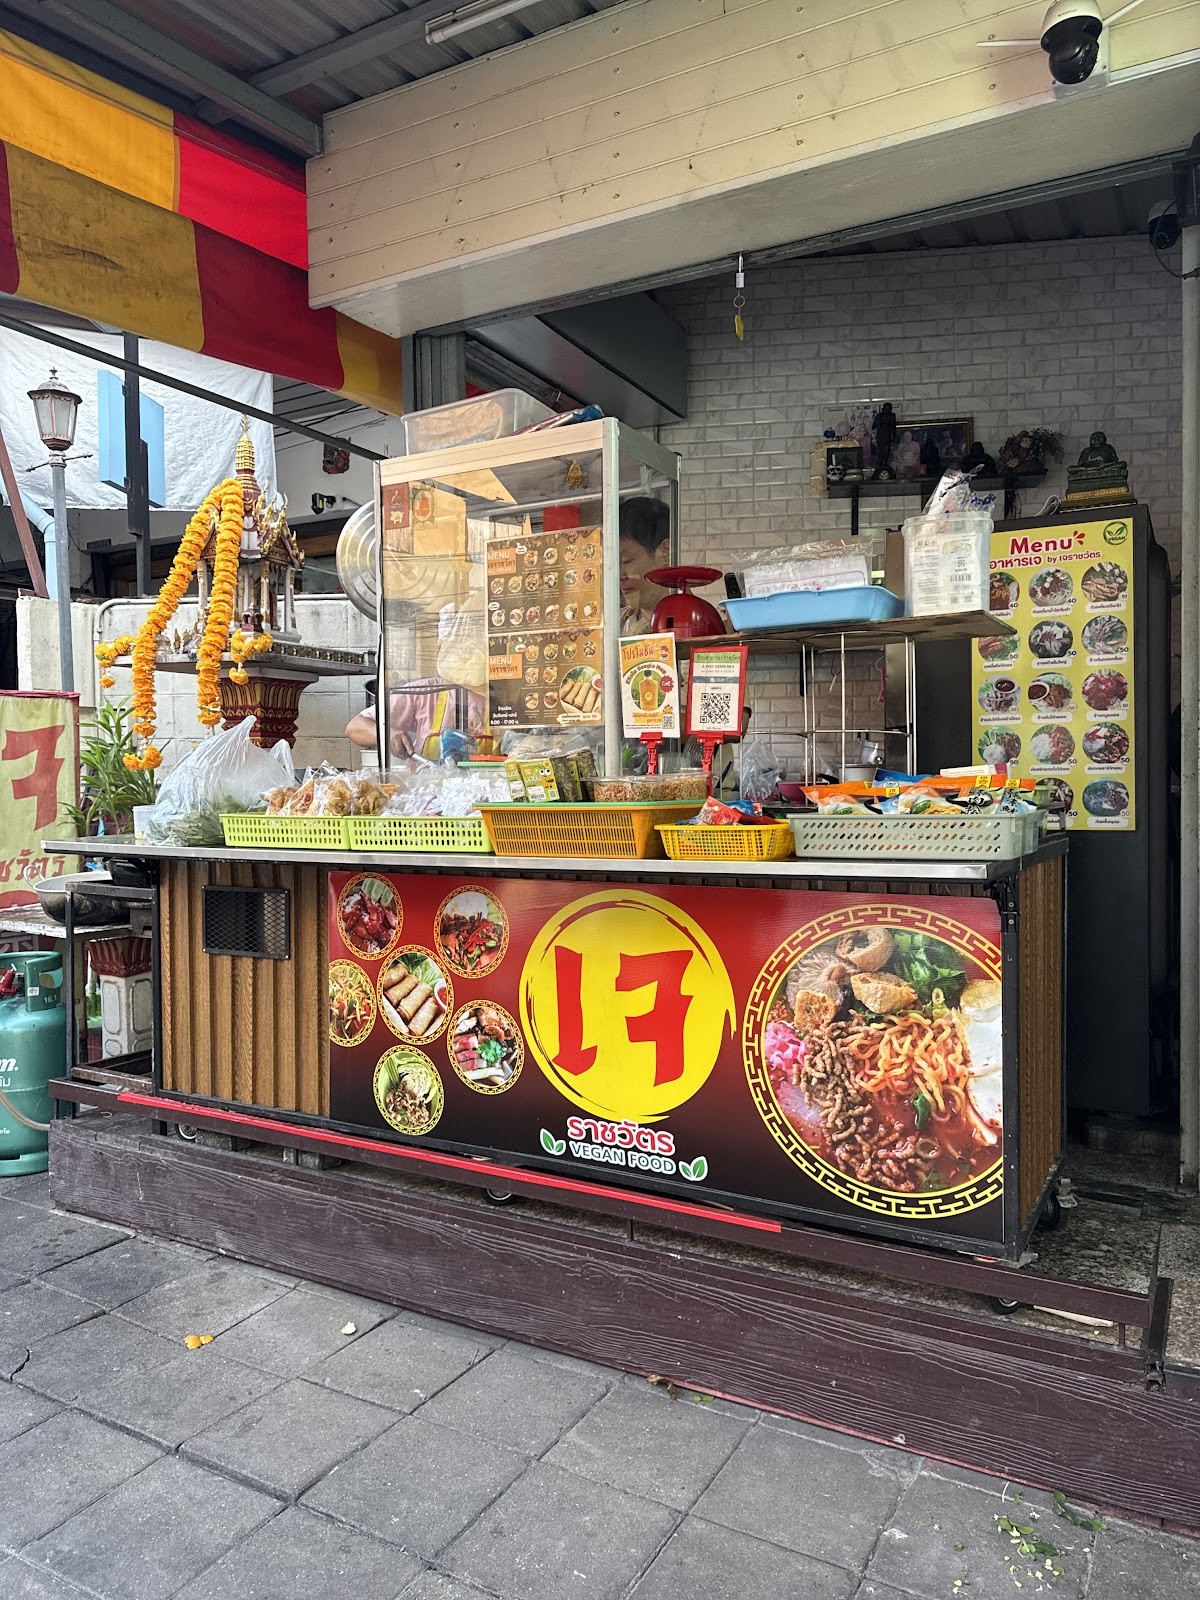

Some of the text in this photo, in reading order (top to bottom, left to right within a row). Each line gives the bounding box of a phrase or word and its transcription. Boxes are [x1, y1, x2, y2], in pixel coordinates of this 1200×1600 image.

[1010, 537, 1073, 555] Menu
[488, 551, 510, 560] MENU
[990, 556, 1042, 569] อาหารเจ
[1060, 551, 1101, 562] เจราชวัตร
[490, 656, 512, 664] MENU
[637, 662, 656, 671] Google
[551, 945, 695, 1088] เจ
[567, 1117, 675, 1154] ราชวัตร
[570, 1142, 676, 1174] VEGAN FOOD
